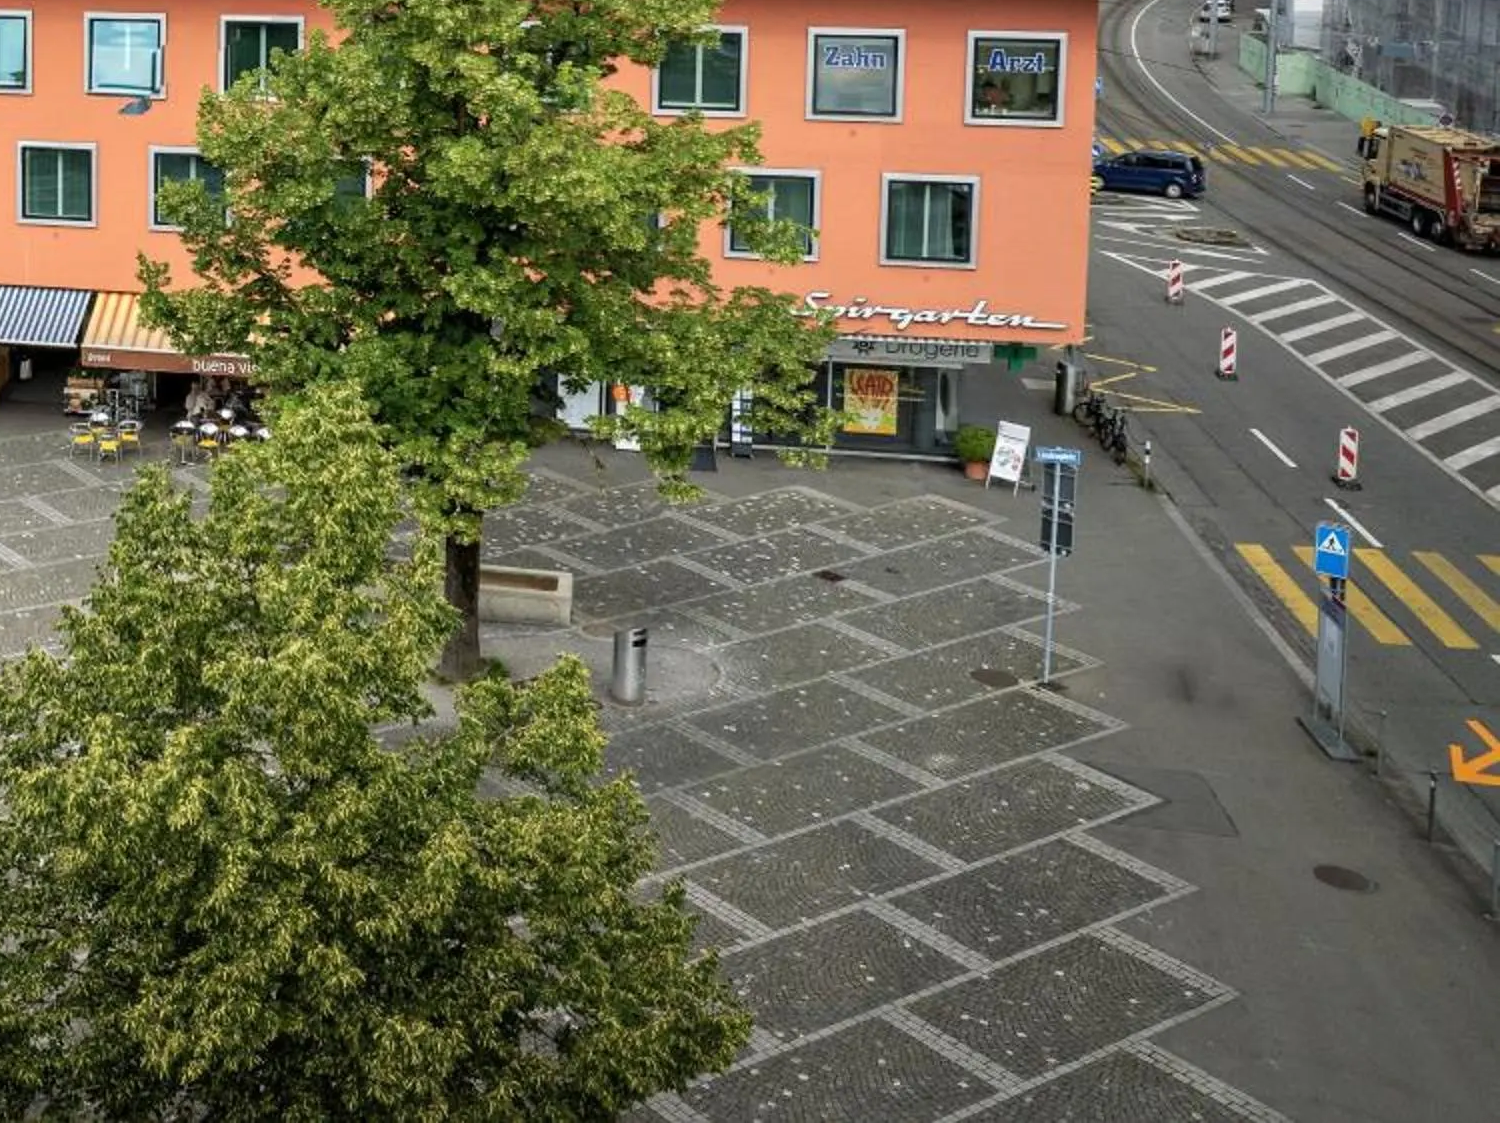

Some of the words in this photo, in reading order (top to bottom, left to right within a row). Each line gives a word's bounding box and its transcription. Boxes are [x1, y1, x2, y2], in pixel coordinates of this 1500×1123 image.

[824, 45, 886, 69] Zahn
[988, 49, 1045, 73] Arzt
[193, 358, 235, 375] buena
